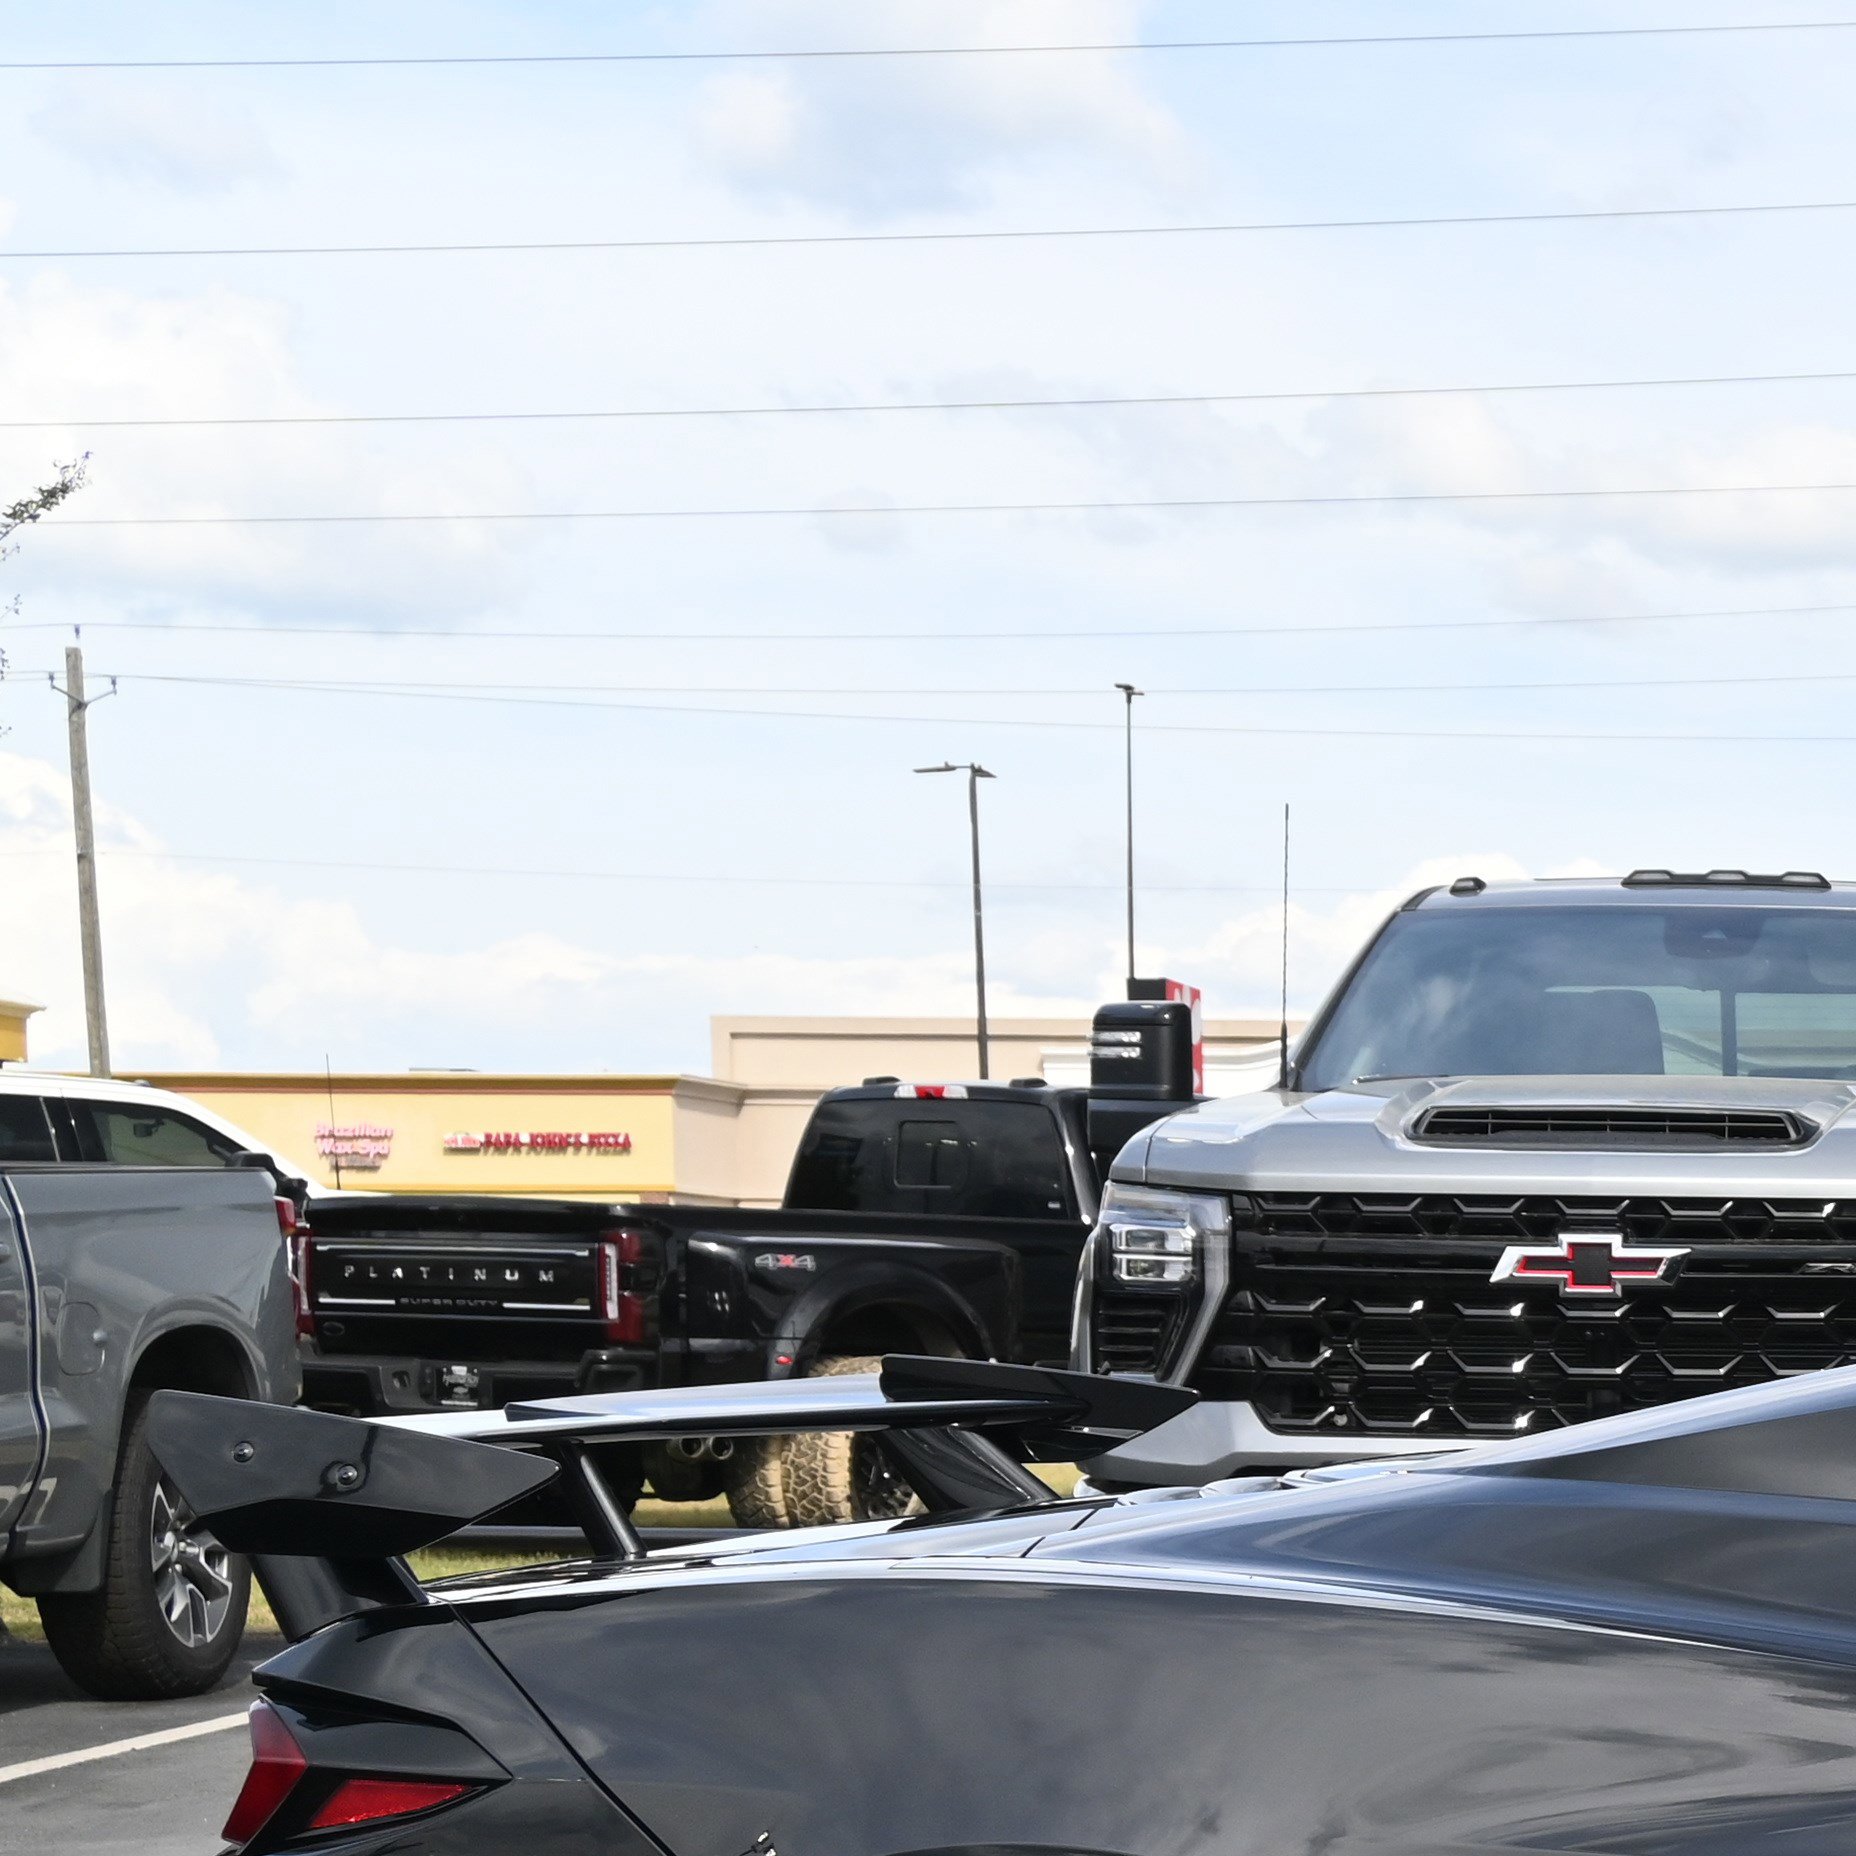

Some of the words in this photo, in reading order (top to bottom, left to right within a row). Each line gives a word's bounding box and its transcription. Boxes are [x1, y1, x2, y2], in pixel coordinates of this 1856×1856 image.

[317, 1138, 354, 1155] Wax
[359, 1138, 390, 1159] Spa
[483, 1132, 522, 1148] PAPA
[587, 1132, 632, 1149] PIZZA
[343, 1264, 555, 1283] PLATINUM
